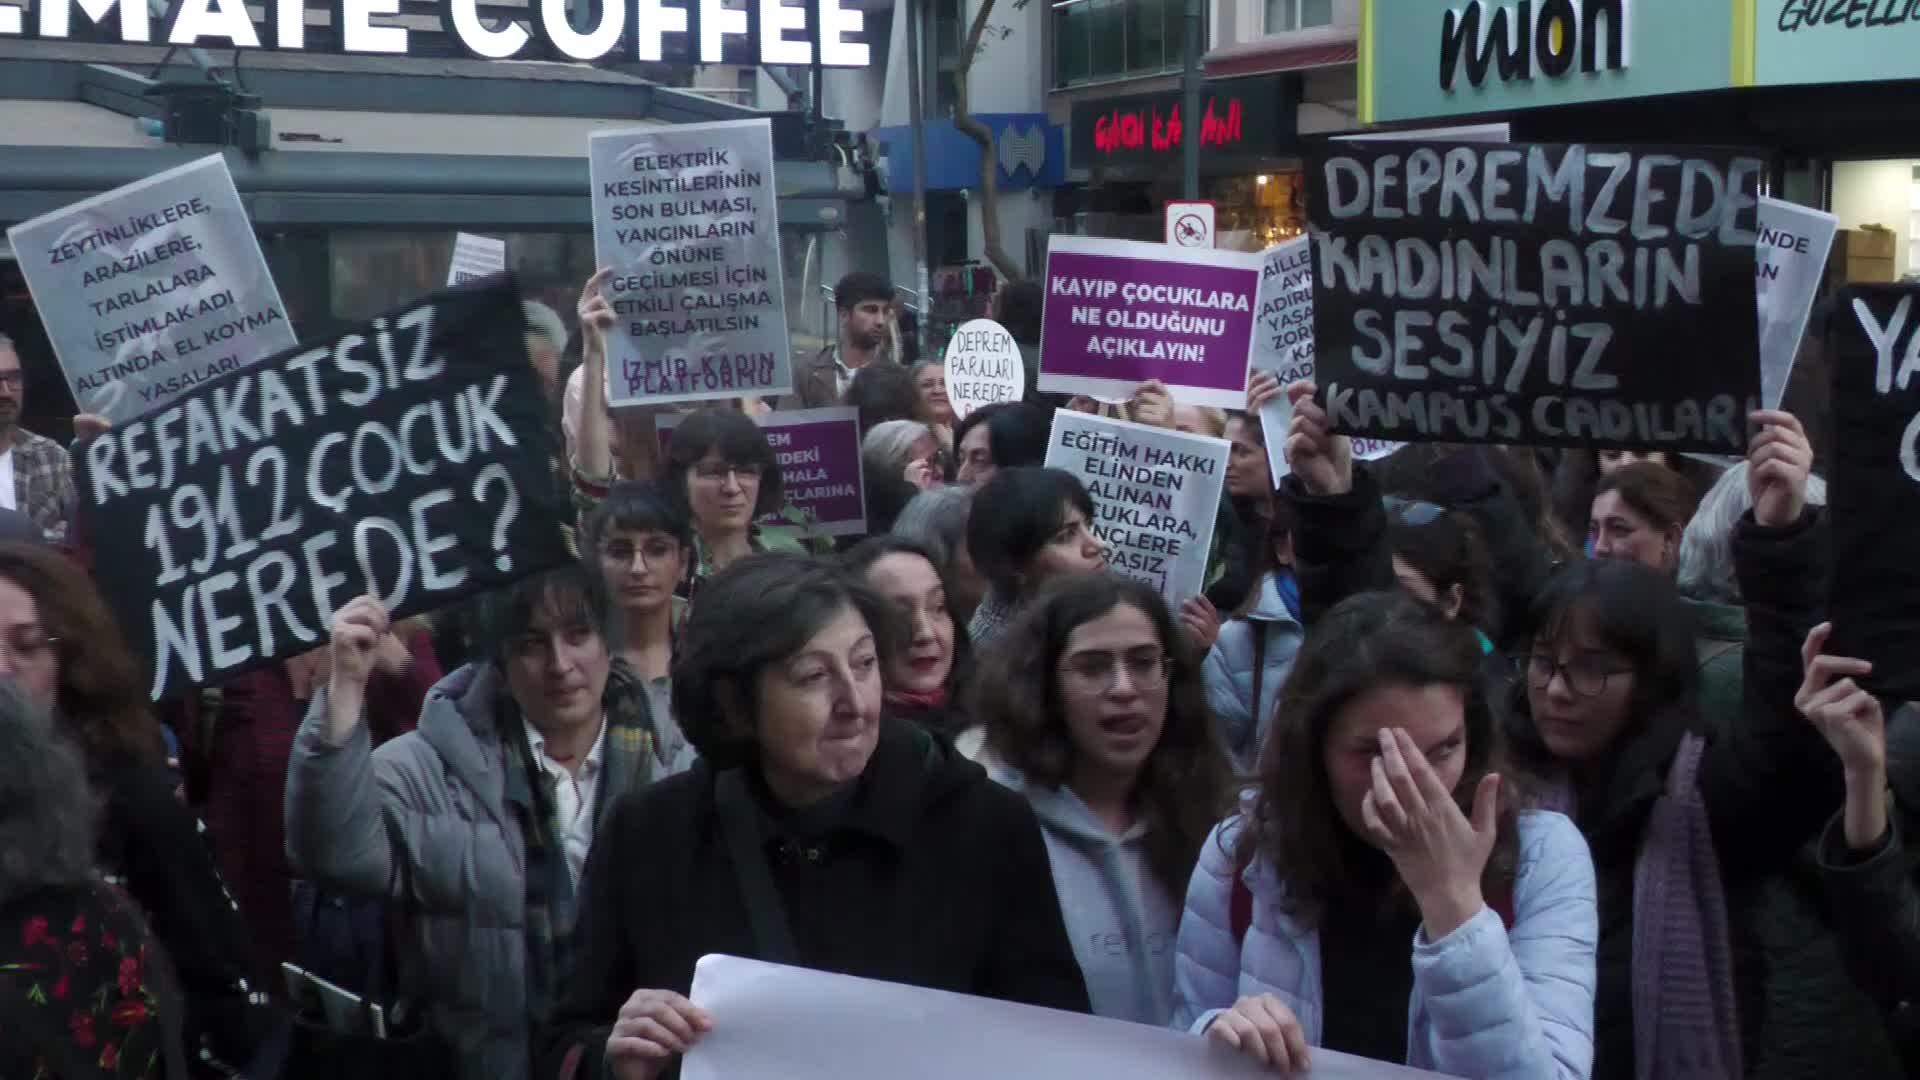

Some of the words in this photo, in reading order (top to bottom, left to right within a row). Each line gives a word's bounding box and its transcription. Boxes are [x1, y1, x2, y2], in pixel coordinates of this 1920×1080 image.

[633, 147, 728, 171] ELEKTRİK
[604, 169, 761, 197] KESİNTİLERİNİN
[1324, 145, 1761, 247] DEPREMZEDE
[612, 204, 654, 220] SON
[661, 197, 757, 217] BULMASI,
[48, 197, 212, 265] ZEYTİNLİKLERE,
[616, 221, 755, 243] YANGINLARIN
[82, 235, 203, 288] ARAZİLERE,
[650, 246, 724, 264] ÖNÜNE
[1263, 250, 1311, 280] AİLLE
[612, 269, 719, 295] GEÇİLMESİ
[726, 264, 767, 288] İÇİN
[1318, 234, 1703, 310] KADINLARIN
[89, 264, 216, 316] TARLALARA
[680, 291, 772, 314] ÇALIŞMA
[1052, 276, 1117, 298] KAYIP
[1121, 282, 1249, 312] ÇOCUKLARA
[96, 304, 194, 351] İSTİMLAK
[199, 290, 234, 318] ADI
[632, 316, 759, 339] BAŞLATILSIN
[1072, 306, 1101, 325] NE
[1106, 308, 1225, 336] OLDUĞUNU
[75, 350, 167, 393] ALTINDA
[175, 341, 200, 357] EL
[203, 308, 284, 346] KOYMA
[957, 331, 1012, 353] DEPREM
[1087, 334, 1205, 363] AÇIKLAYIN!
[1271, 325, 1313, 350] ZOR
[1351, 307, 1620, 394] SESİYİZ
[138, 355, 241, 403] YASALARI
[951, 355, 1014, 380] PARALARI
[1274, 362, 1313, 386] KAD
[86, 304, 446, 504] REFAKATSİZ
[953, 382, 1015, 401] NEREDE?
[1326, 381, 1521, 440] KAMPÜS
[766, 433, 791, 446] EM
[1061, 429, 1138, 461] EĞİTİM
[1144, 446, 1215, 475] HAKKI
[776, 446, 820, 465] DEKİ
[145, 446, 301, 585] 1912
[306, 374, 518, 511] ÇOCUK
[1084, 456, 1183, 491] ELİNDEN
[1087, 480, 1173, 511] ALINAN
[1093, 524, 1181, 556] NÇLERE
[1102, 547, 1167, 580] RASIZ,
